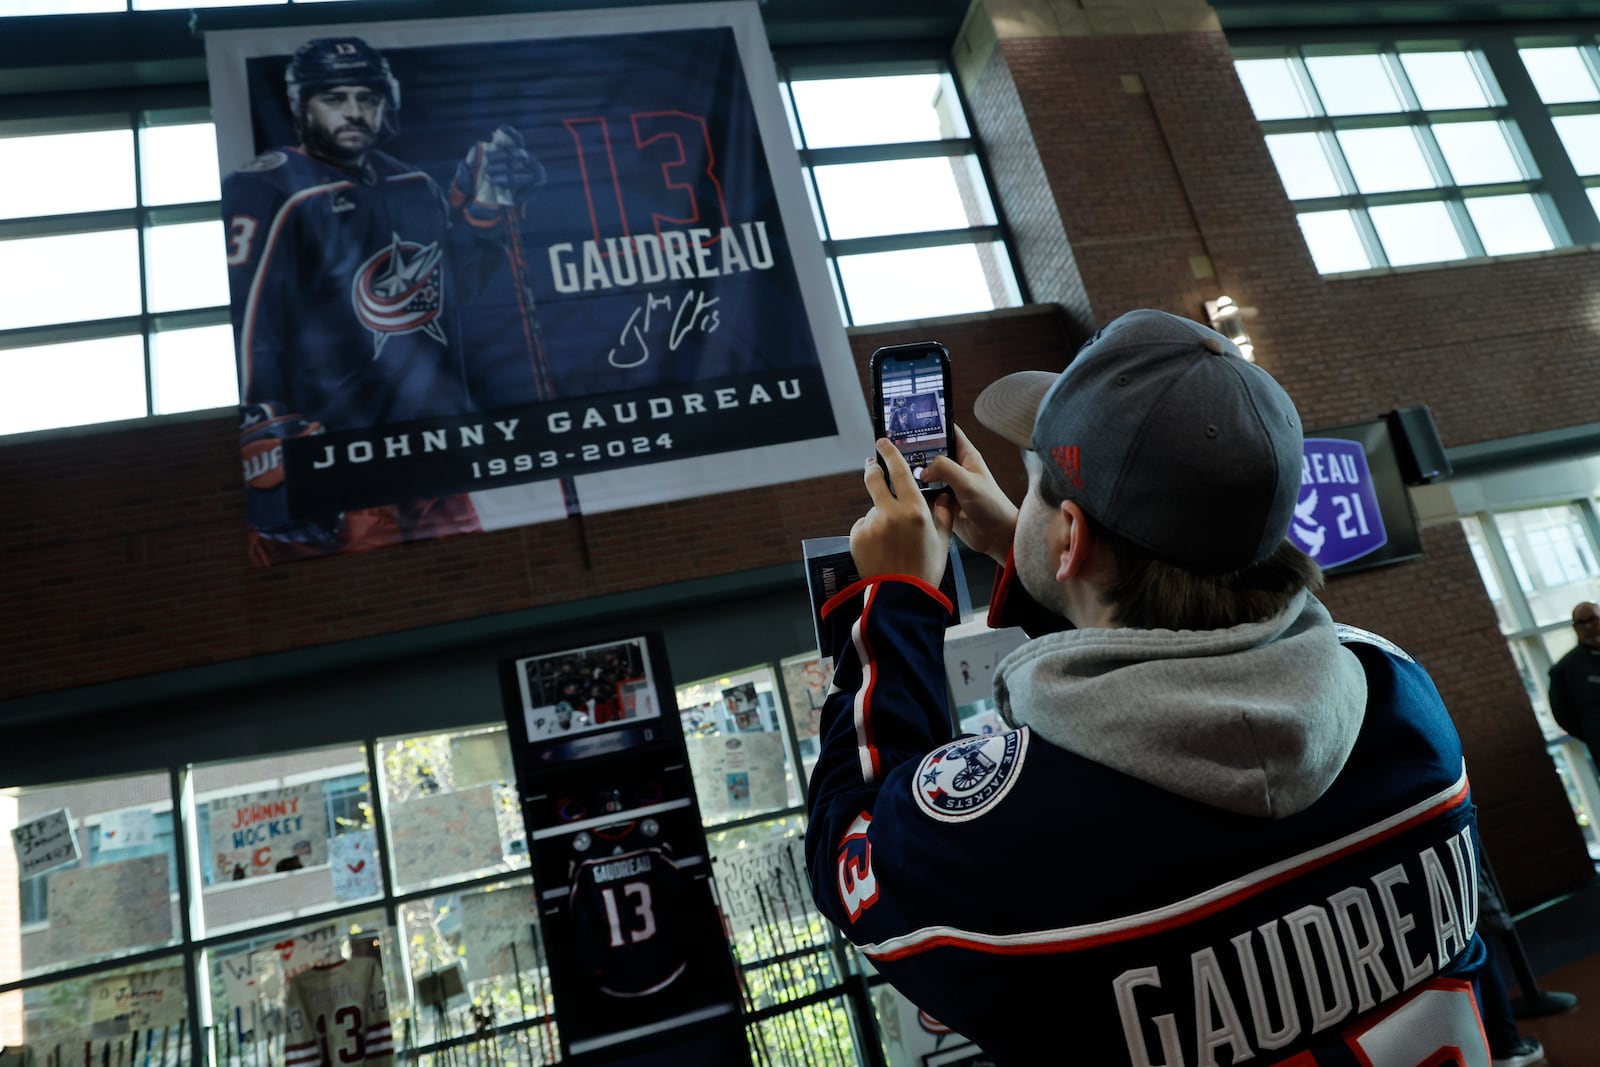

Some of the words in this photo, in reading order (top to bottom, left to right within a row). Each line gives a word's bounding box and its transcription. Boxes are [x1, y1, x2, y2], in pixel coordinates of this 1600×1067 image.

[563, 110, 730, 257] 13
[548, 220, 775, 294] GAUDREAU
[313, 418, 519, 469] JOHNNY
[547, 378, 802, 433] GAUDREAU
[472, 433, 673, 478] 1993-2024
[1301, 453, 1360, 485] REAU
[1331, 493, 1370, 539] 21
[1003, 733, 1016, 764] BLUE
[946, 770, 1005, 808] JACKETS
[232, 797, 299, 830] JOHNNY
[232, 815, 303, 849] HOCKEY
[601, 881, 657, 947] 13
[1112, 824, 1480, 1067] GAUDREAU
